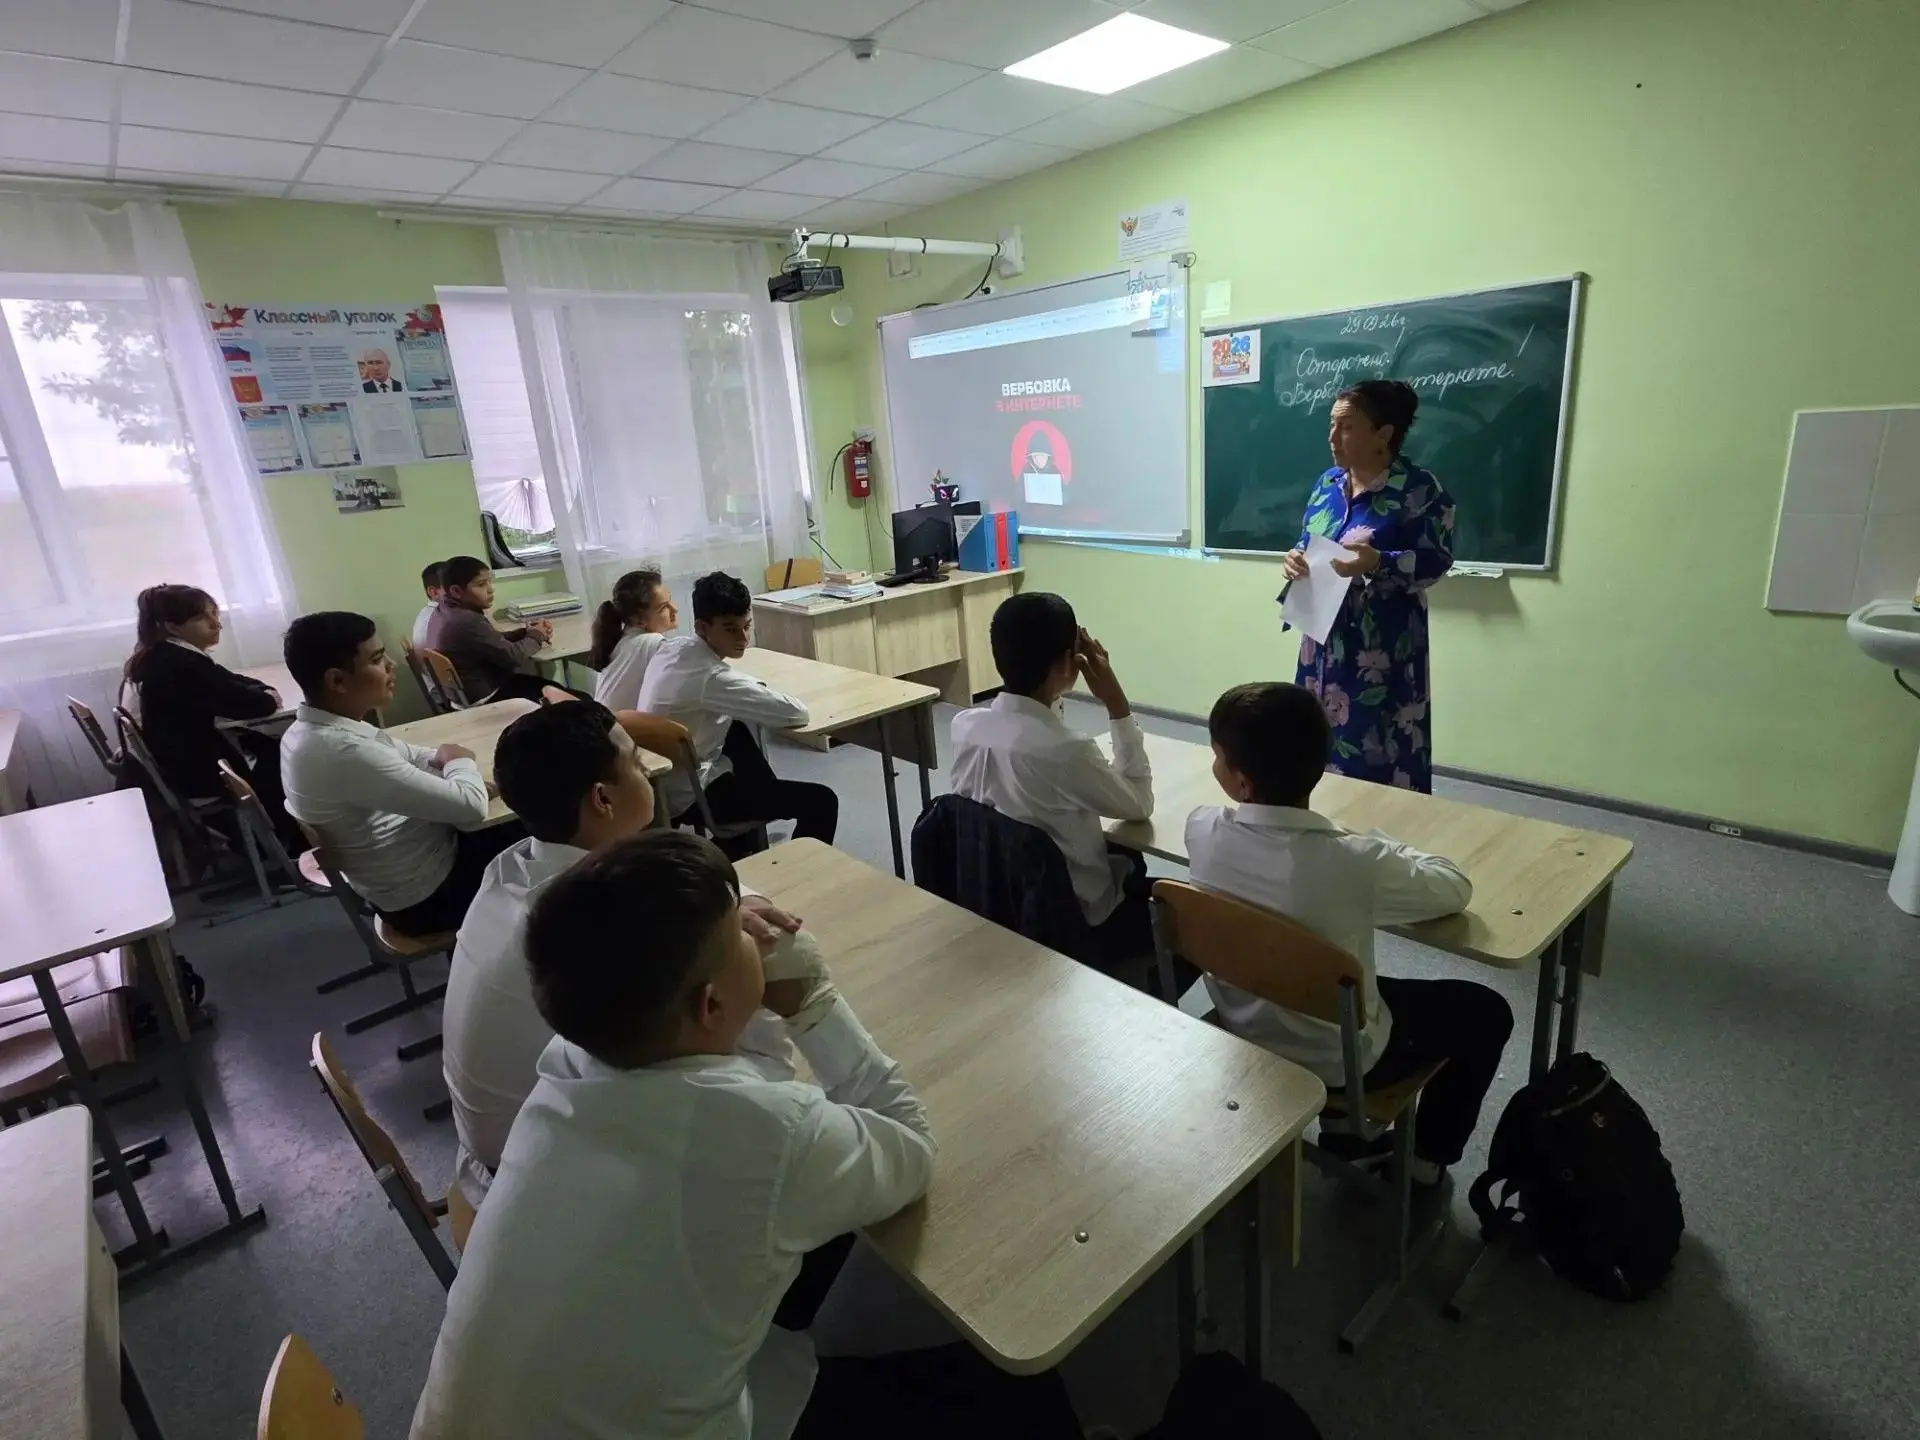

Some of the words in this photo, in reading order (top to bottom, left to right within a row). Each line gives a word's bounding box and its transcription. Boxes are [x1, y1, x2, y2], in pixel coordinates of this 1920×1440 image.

[253, 308, 341, 324] Классный
[343, 311, 398, 326] уголок
[1211, 335, 1251, 355] 2026
[1001, 377, 1072, 397] ВЕРБОВКА
